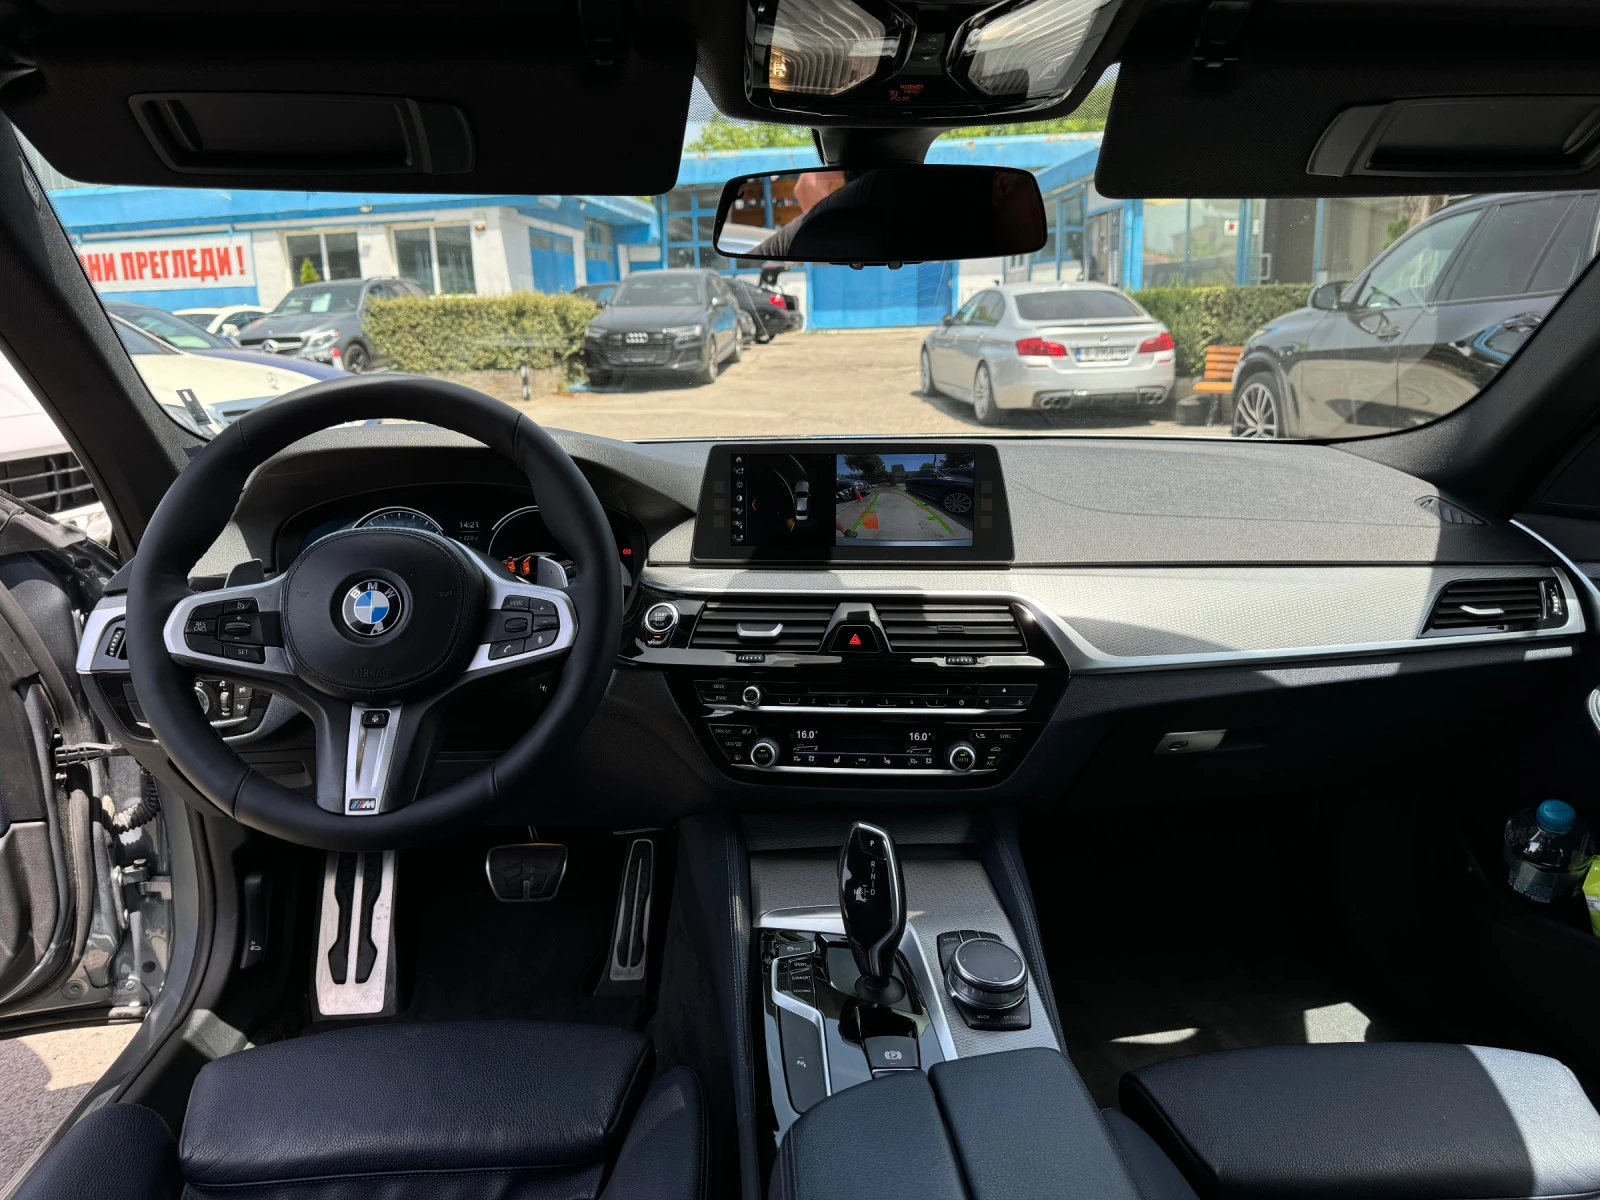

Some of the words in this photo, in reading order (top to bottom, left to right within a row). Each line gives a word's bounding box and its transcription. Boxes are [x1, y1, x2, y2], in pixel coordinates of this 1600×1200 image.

[79, 252, 118, 282] НИ
[459, 521, 479, 529] 14:21
[349, 581, 397, 600] BMW
[870, 873, 876, 881] N
[870, 888, 876, 896] D
